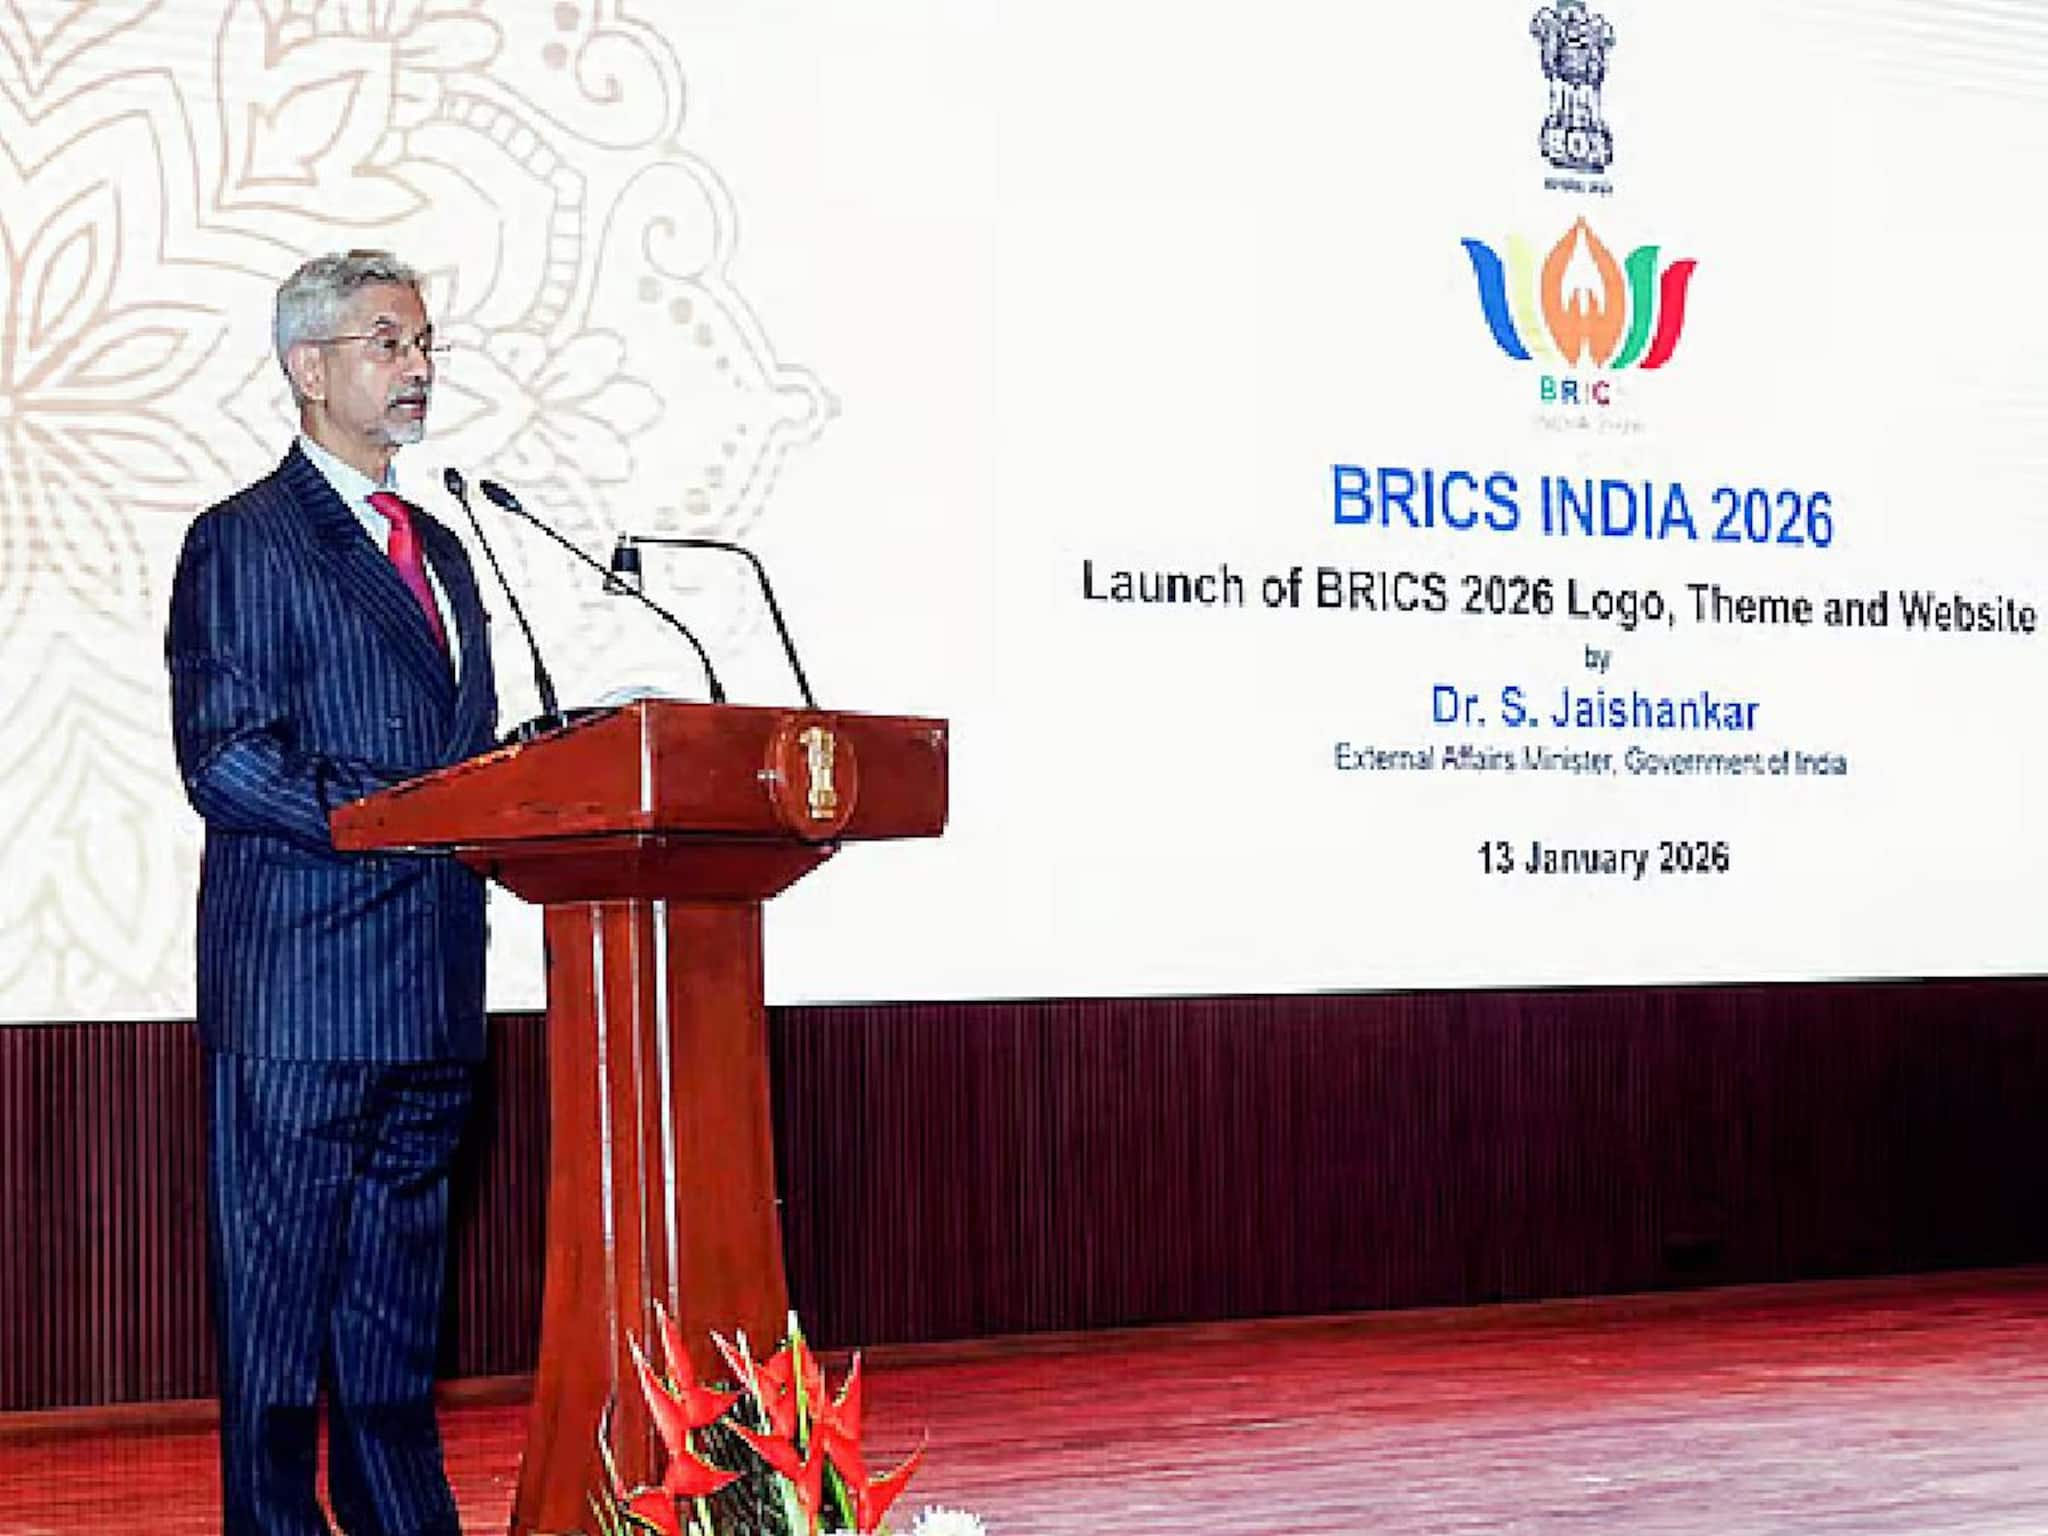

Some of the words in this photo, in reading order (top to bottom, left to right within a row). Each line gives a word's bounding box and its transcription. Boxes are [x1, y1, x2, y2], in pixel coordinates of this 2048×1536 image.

[1331, 464, 1521, 532] BRICS
[1541, 475, 1699, 541] INDIA
[1711, 487, 1834, 549] 2026
[1083, 559, 1244, 608] Launch
[1261, 566, 1303, 609] of
[1316, 566, 1450, 613] BRICS
[1460, 574, 1554, 616] 2026
[1567, 577, 1677, 633] Logo,
[1685, 583, 1814, 627] Theme
[1823, 589, 1889, 628] and
[1898, 590, 2039, 636] Website
[1584, 643, 1611, 674] by
[1432, 684, 1486, 727] Dr.
[1501, 686, 1539, 728] S.
[1550, 686, 1761, 732] Jaishankar
[1334, 741, 1435, 771] External
[1441, 744, 1518, 771] Affairs
[1767, 749, 1790, 776] of
[1794, 750, 1848, 776] India
[1477, 840, 1515, 875] 13
[1524, 840, 1650, 882] January
[1656, 840, 1730, 875] 2026
